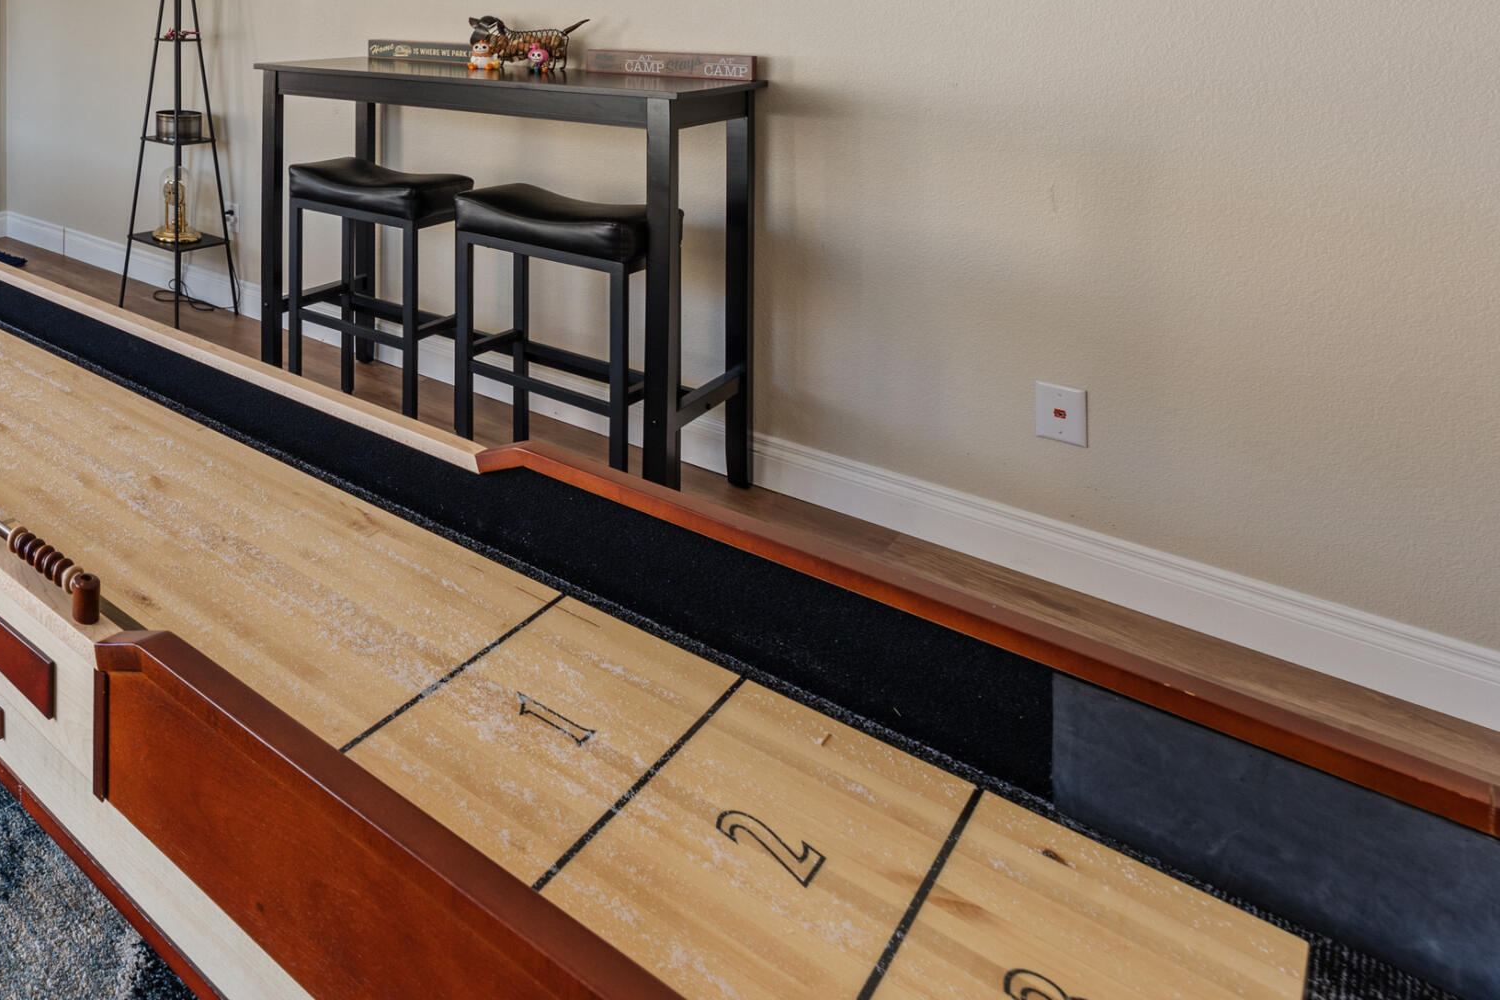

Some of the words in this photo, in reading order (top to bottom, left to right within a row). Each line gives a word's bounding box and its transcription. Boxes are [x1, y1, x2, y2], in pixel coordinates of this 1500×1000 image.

[625, 61, 665, 73] CAMP
[704, 64, 748, 77] CAMP
[715, 808, 828, 888] 2
